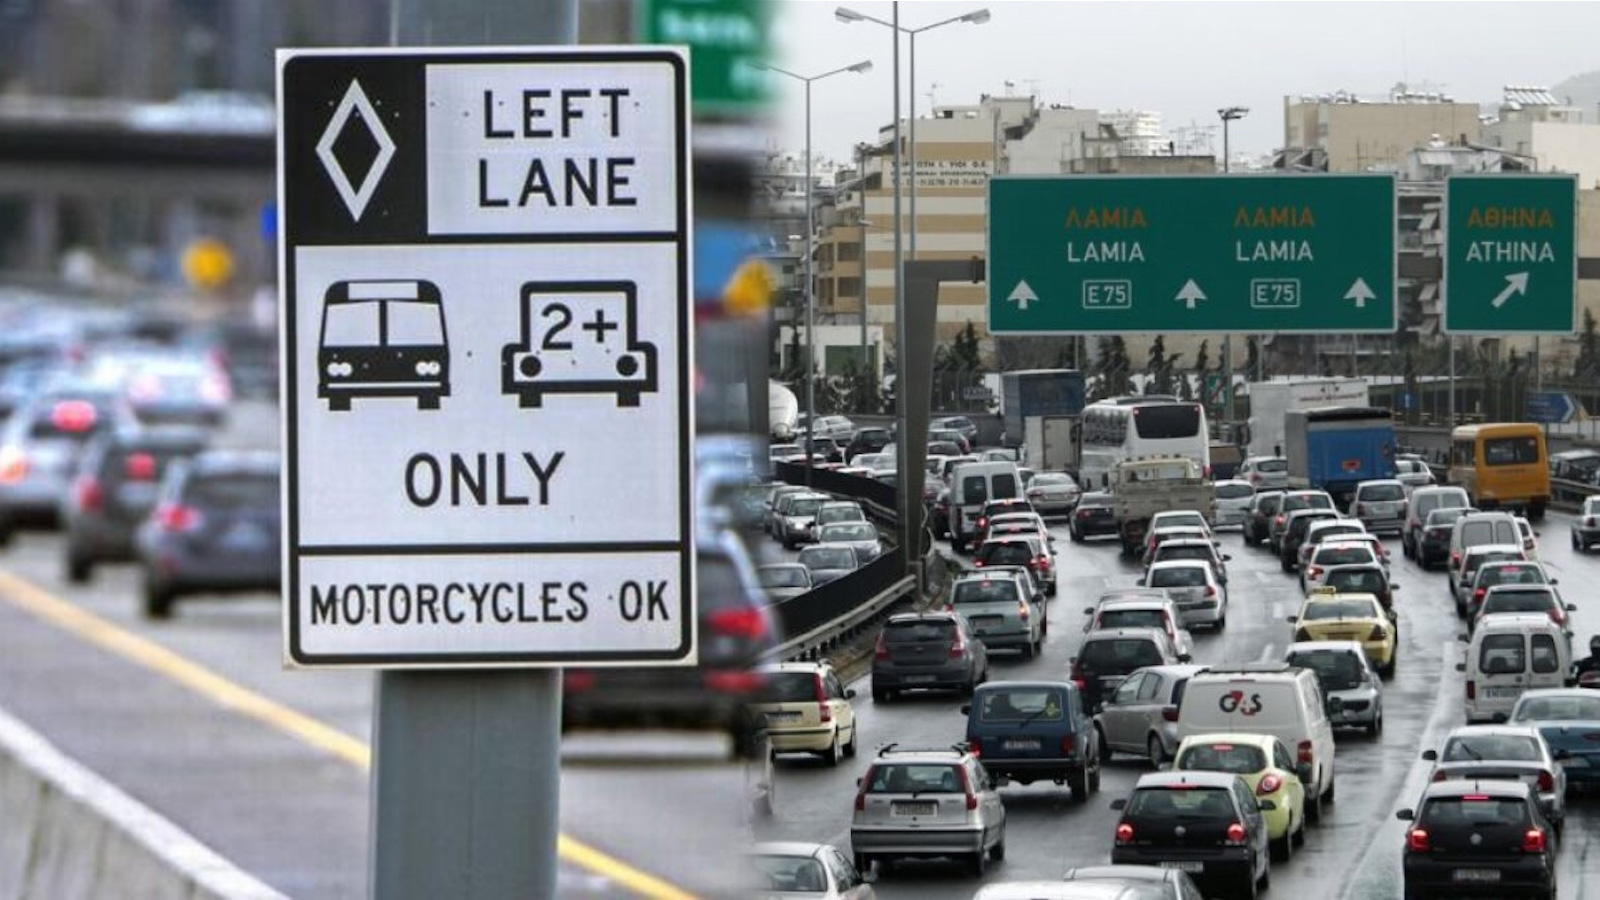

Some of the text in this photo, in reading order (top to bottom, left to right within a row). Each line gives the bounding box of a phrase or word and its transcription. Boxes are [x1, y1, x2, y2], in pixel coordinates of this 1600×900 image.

[485, 89, 629, 138] LEFT
[480, 158, 636, 207] LANE
[1065, 206, 1148, 229] ΛΑΜΙΑ
[1234, 205, 1316, 228] ΛΑΜΙΑ
[1468, 207, 1554, 229] ΑΘΗΝΑ
[1068, 242, 1145, 262] LAMIA
[1236, 240, 1313, 261] LAMIA
[1466, 241, 1555, 262] ATHINA
[542, 303, 617, 350] 2+
[406, 452, 564, 507] ONLY
[311, 581, 670, 625] MOTORCYCLES OK
